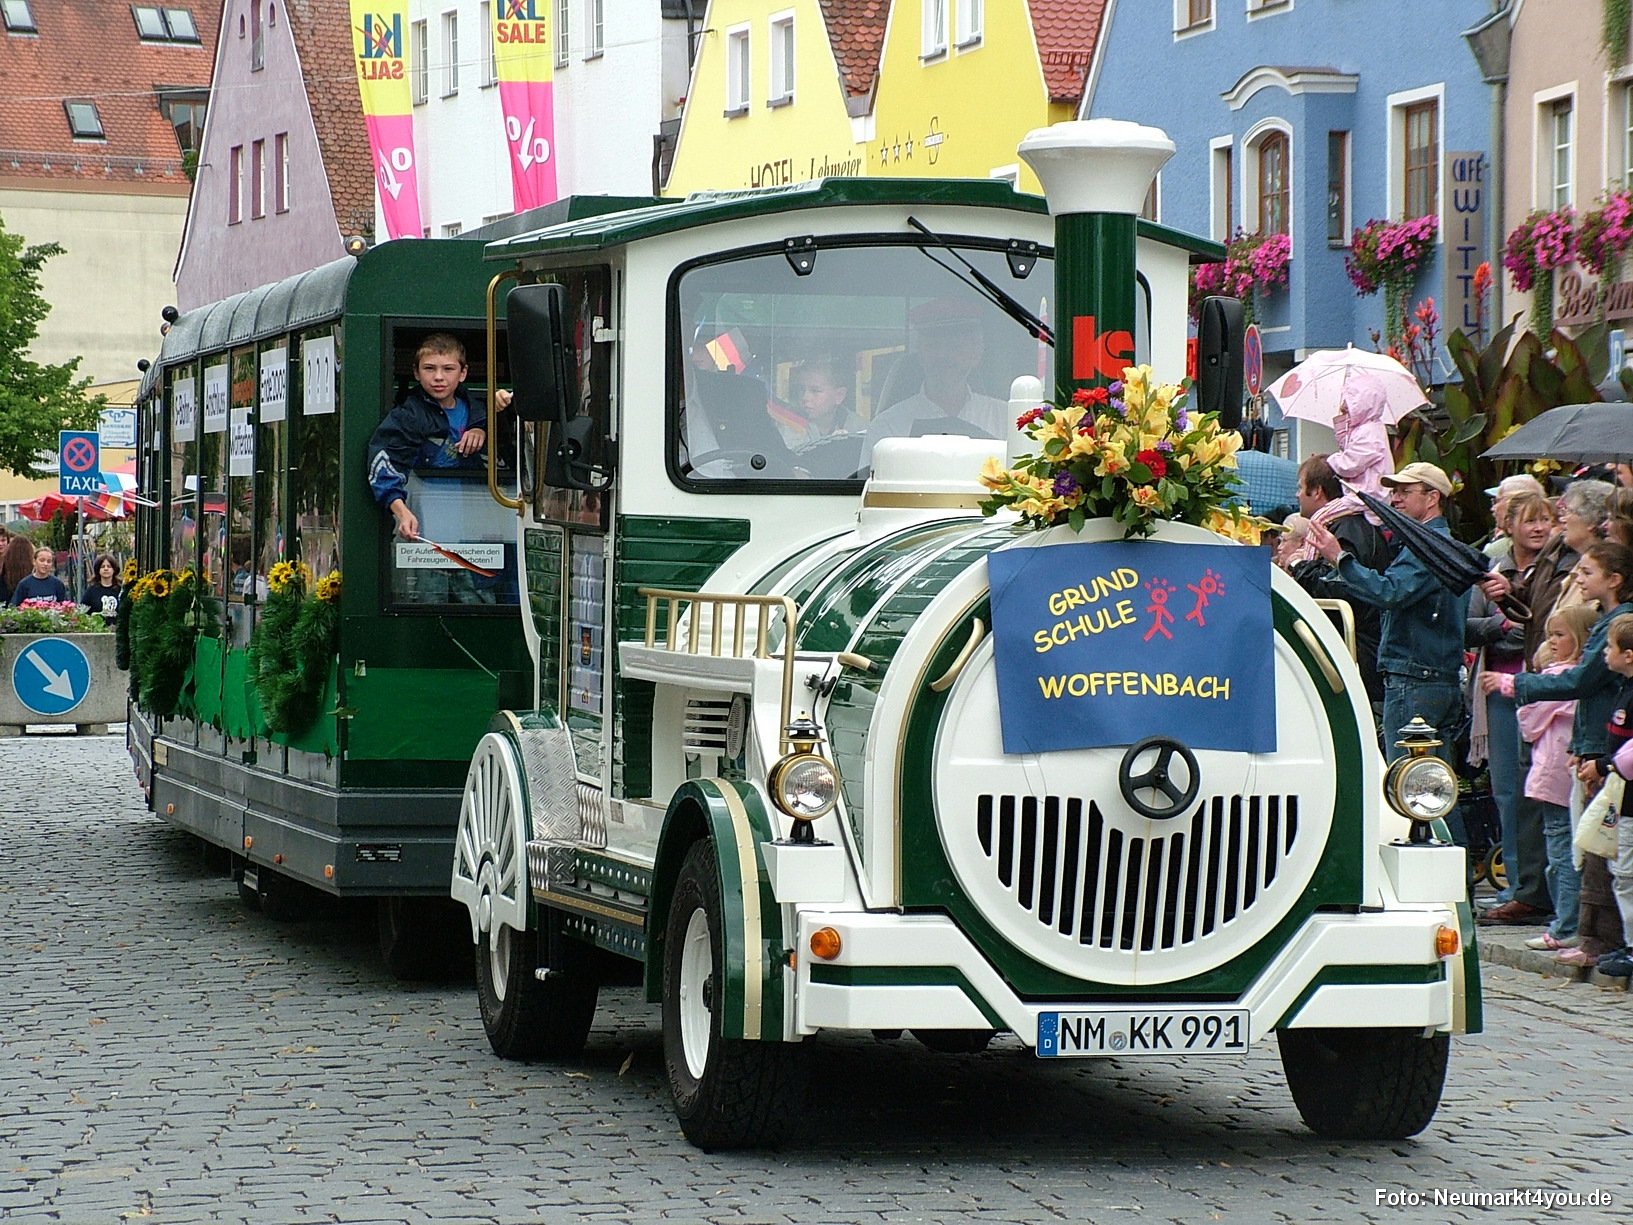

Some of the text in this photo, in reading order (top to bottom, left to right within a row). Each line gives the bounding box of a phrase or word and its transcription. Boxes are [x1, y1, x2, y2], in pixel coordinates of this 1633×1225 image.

[497, 22, 546, 44] SALE
[751, 158, 793, 188] HOTEL
[63, 476, 96, 491] TAXI
[401, 547, 413, 555] Der
[407, 556, 449, 564] Fahrzeugen
[1049, 567, 1139, 616] GRUND
[1034, 600, 1137, 653] SCHULE
[1038, 672, 1230, 700] WOFFENBACH
[1044, 1038, 1052, 1049] D
[1061, 1015, 1244, 1050] NM KK 991
